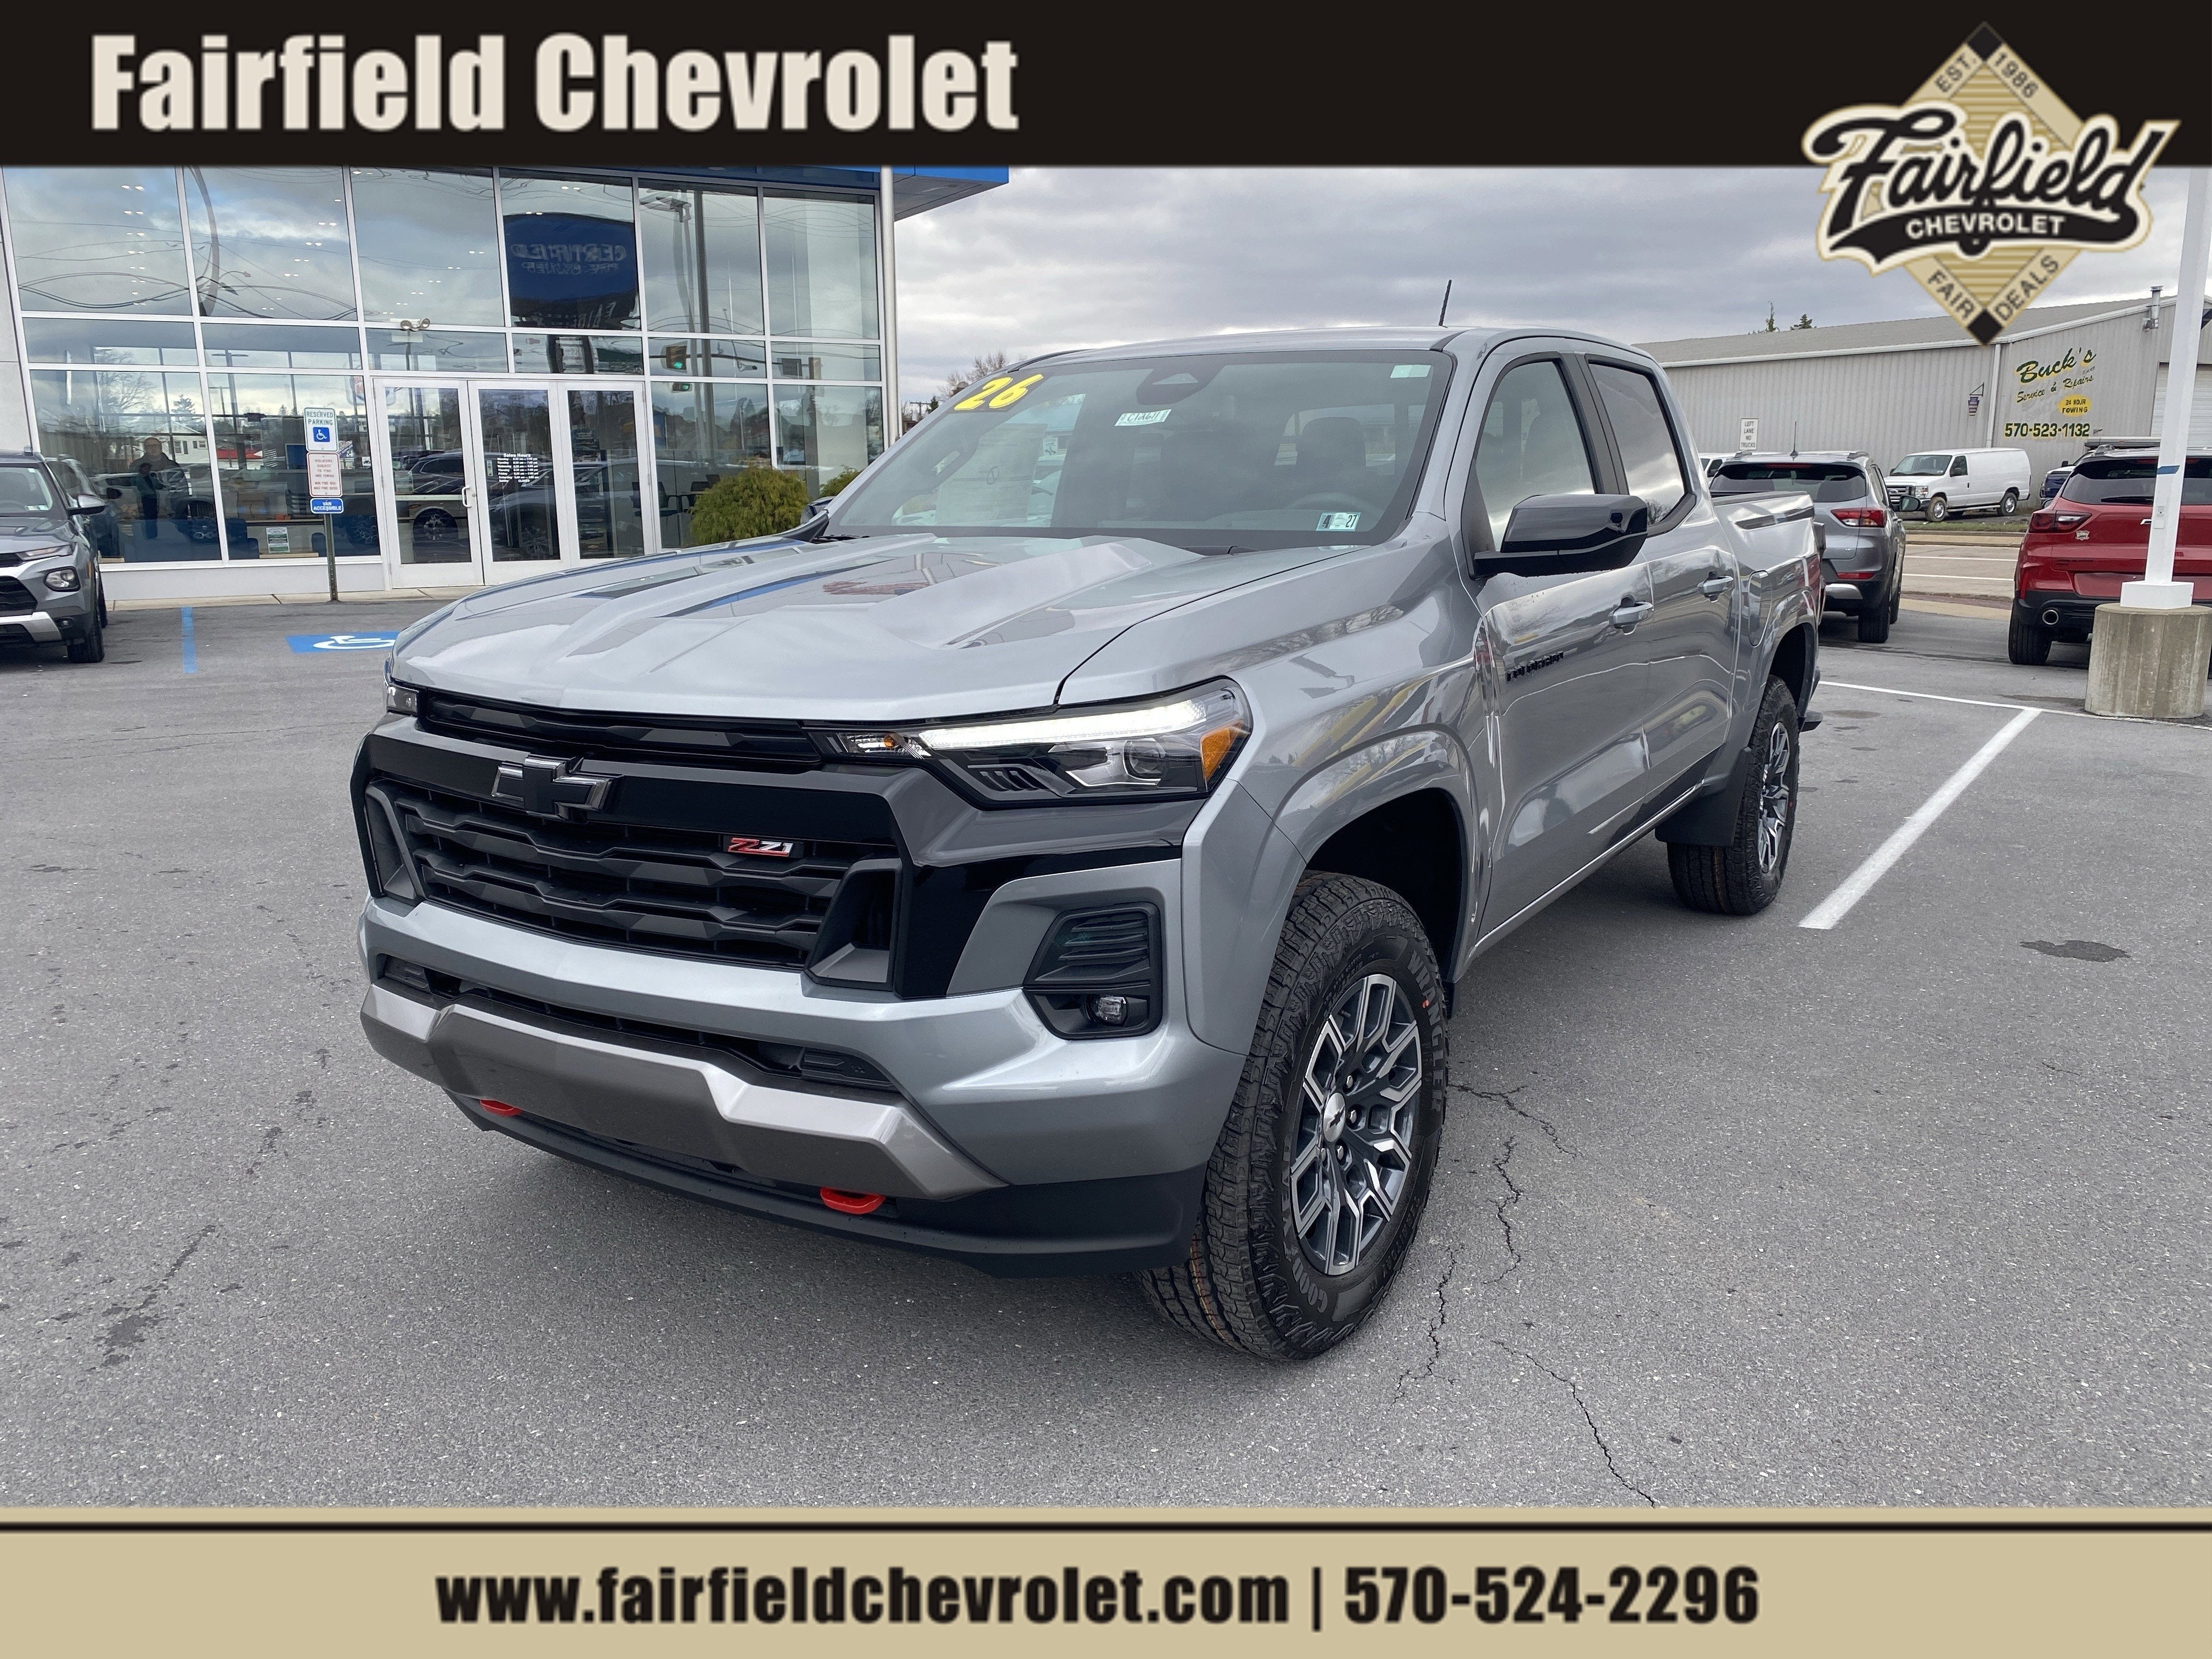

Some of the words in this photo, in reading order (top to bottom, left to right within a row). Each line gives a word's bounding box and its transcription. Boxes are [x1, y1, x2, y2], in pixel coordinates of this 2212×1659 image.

[2016, 347, 2097, 383] Buck's
[953, 374, 1044, 411] 26
[2017, 389, 2045, 403] Service
[2005, 422, 2090, 437] 570-523-1132
[1323, 515, 1331, 528] 4
[1345, 515, 1357, 528] 27
[727, 837, 793, 857] Z71
[1407, 949, 1444, 1112] WRANGLER
